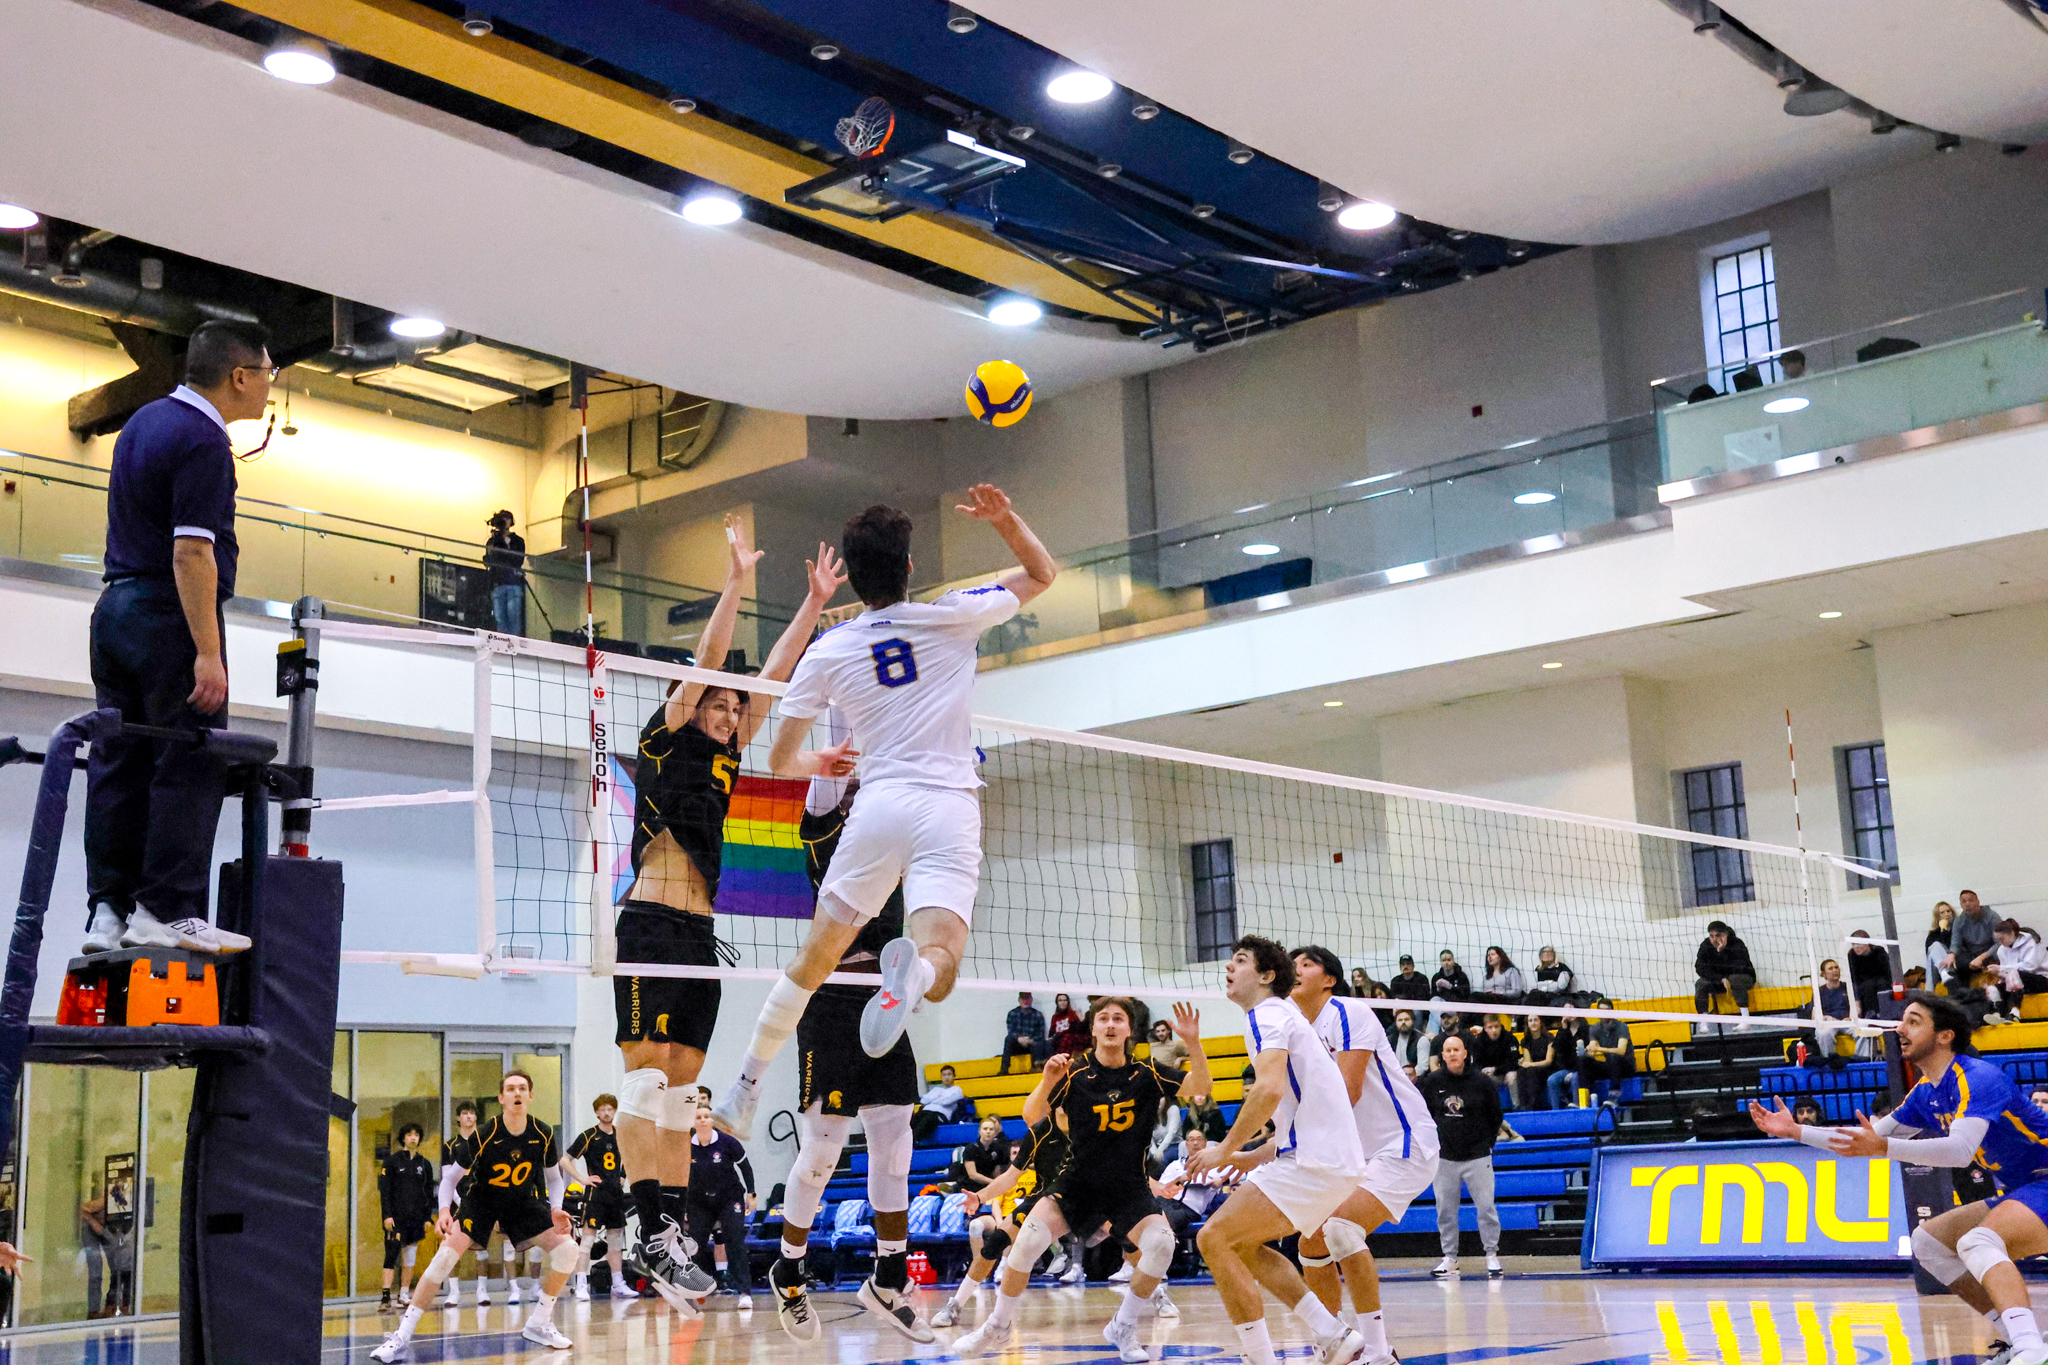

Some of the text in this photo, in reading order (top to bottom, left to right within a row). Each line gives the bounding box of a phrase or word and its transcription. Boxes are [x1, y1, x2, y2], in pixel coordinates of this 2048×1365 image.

[870, 637, 918, 688] 8
[595, 723, 607, 792] Senoh
[711, 754, 739, 795] 5
[1092, 1098, 1135, 1132] 15
[488, 1161, 532, 1187] 20
[603, 1152, 617, 1170] 8
[1631, 1158, 1890, 1245] TMU
